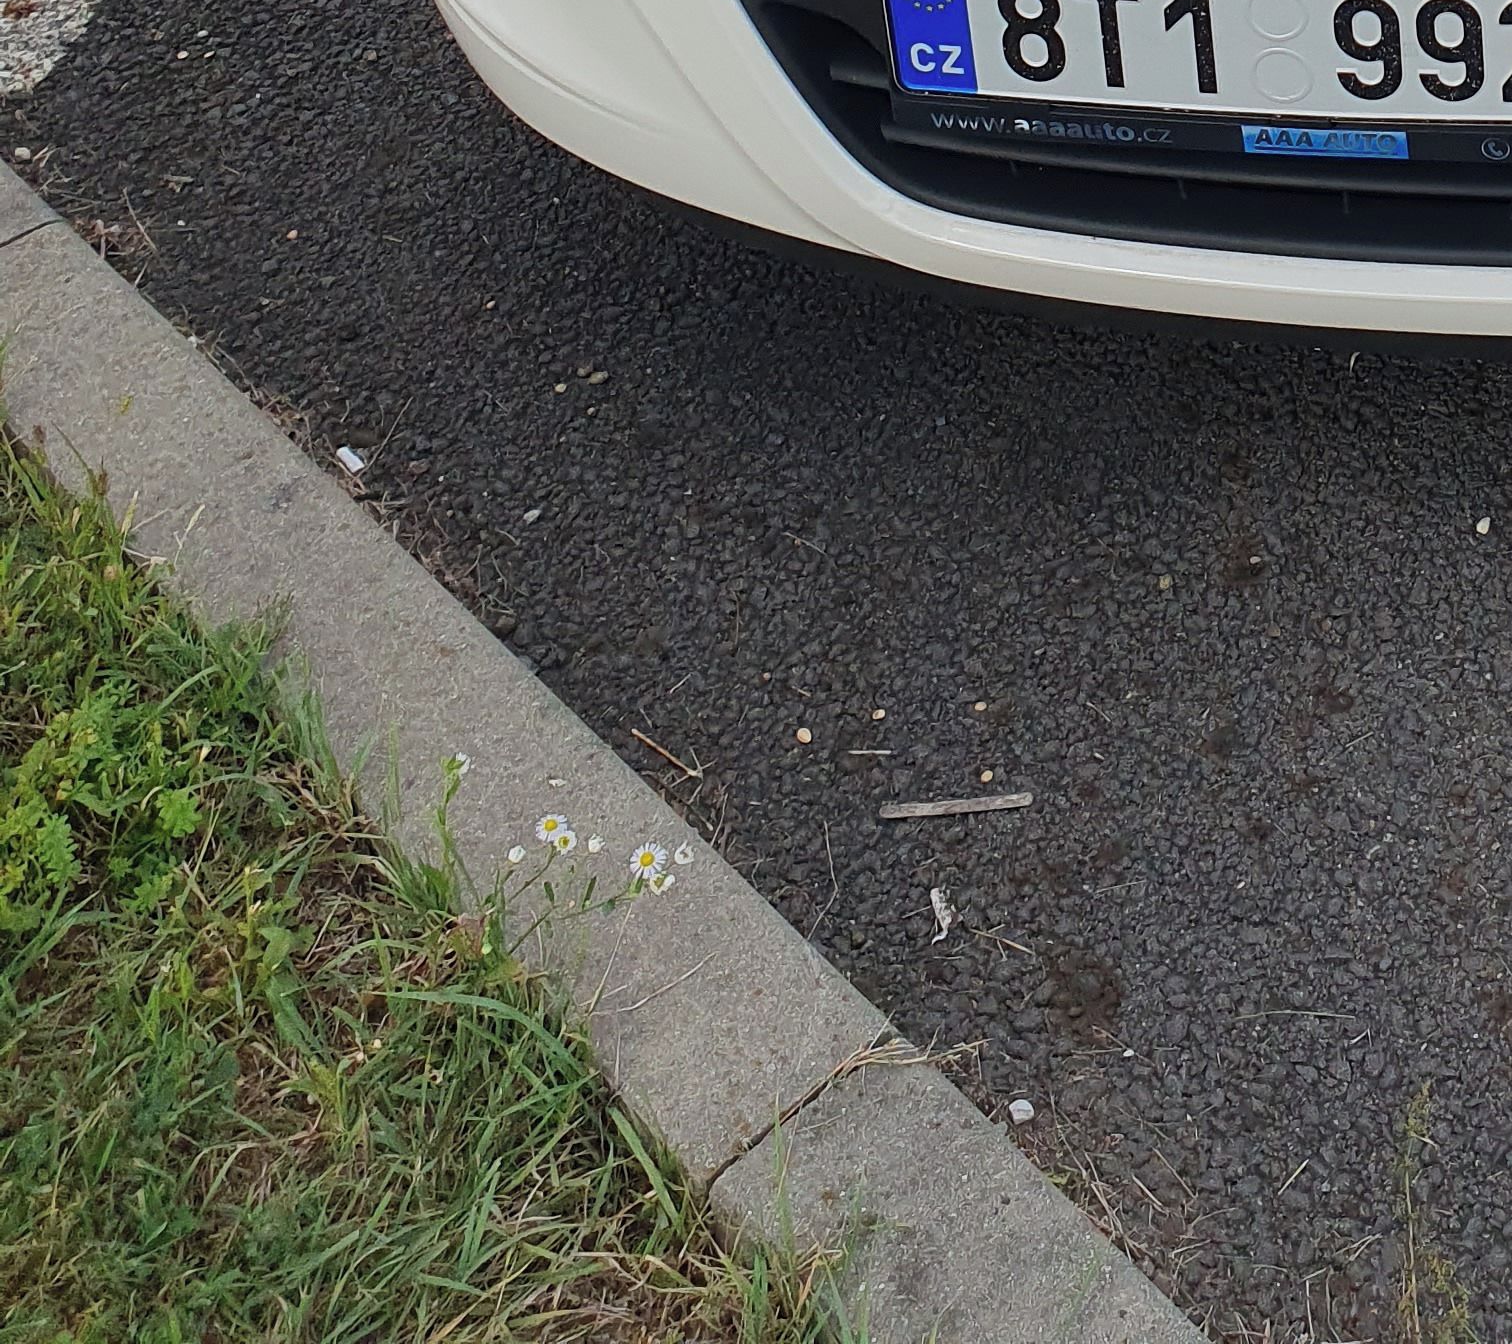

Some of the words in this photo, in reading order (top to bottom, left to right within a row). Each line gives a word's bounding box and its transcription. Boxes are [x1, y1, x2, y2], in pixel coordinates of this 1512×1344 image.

[909, 42, 965, 75] CZ
[930, 112, 1174, 144] www.aaaauto.cz
[1254, 128, 1314, 148] AAA
[1323, 131, 1397, 150] AUTO
